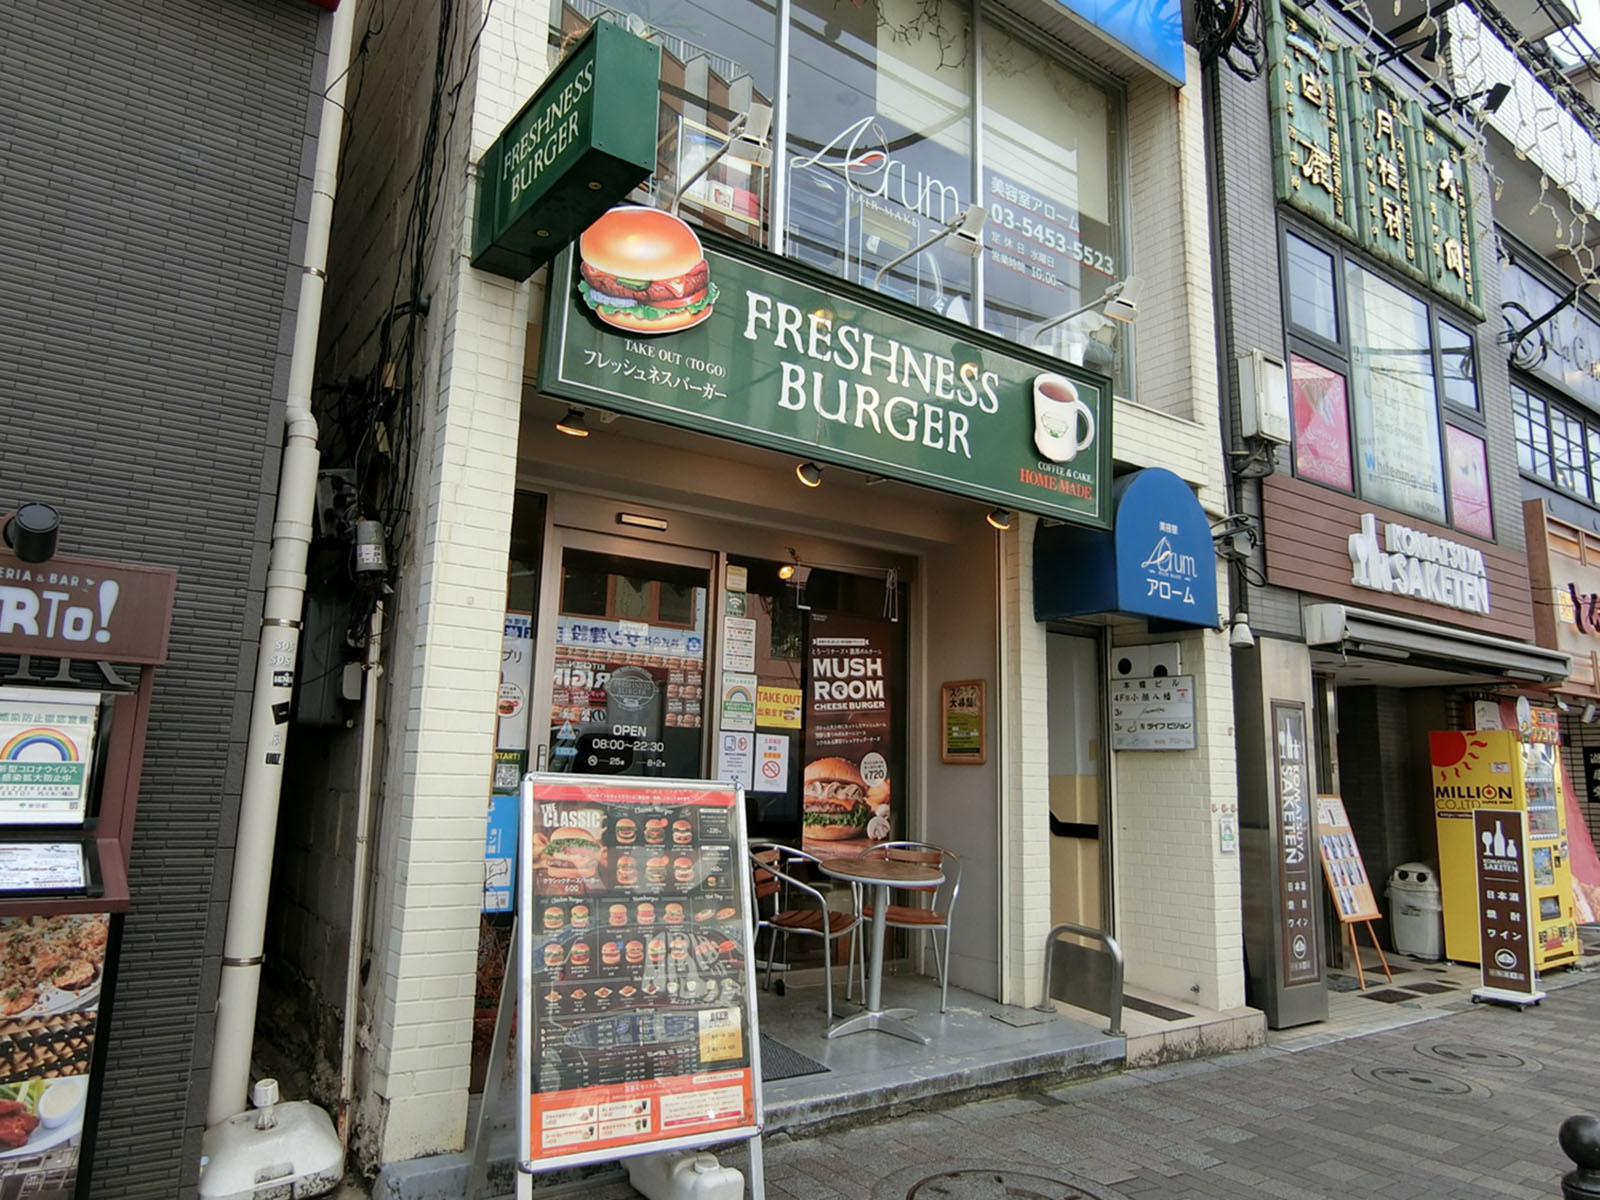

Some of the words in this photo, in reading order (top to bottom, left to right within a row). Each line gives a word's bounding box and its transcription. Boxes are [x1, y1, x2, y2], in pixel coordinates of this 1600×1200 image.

[503, 59, 593, 181] FRESHNESS
[510, 110, 579, 203] BURGER
[991, 203, 1114, 276] 03-5453-5523
[624, 338, 656, 358] TAKE
[658, 349, 683, 366] OUT
[743, 289, 1000, 415] FRESHNESS
[584, 349, 727, 400] フレッシュネスバーガー
[777, 361, 972, 460] BURGER
[1020, 468, 1057, 491] HOME
[1037, 461, 1065, 477] COFFEE
[1066, 468, 1073, 478] &
[1073, 470, 1092, 483] CAKE
[1385, 523, 1486, 579] KOMATSUYA
[49, 573, 79, 587] BAR
[1389, 552, 1489, 615] SAKETEN
[1146, 578, 1195, 605] アローム
[812, 657, 884, 678] MUSH
[758, 691, 781, 703] TAKE
[782, 694, 802, 705] OUT
[814, 679, 885, 701] ROOM
[814, 702, 848, 711] CHEESE
[849, 700, 885, 709] BURGER
[612, 724, 647, 737] OPEN
[1436, 784, 1512, 799] MILLION
[540, 803, 556, 813] THE
[1281, 764, 1298, 865] SAKETEN
[543, 811, 601, 828] CLASSIC
[1484, 864, 1519, 873] SAKETEN
[1486, 890, 1520, 903] 日本酒
[1288, 917, 1309, 928] ワイン
[1487, 929, 1522, 941] ワイン
